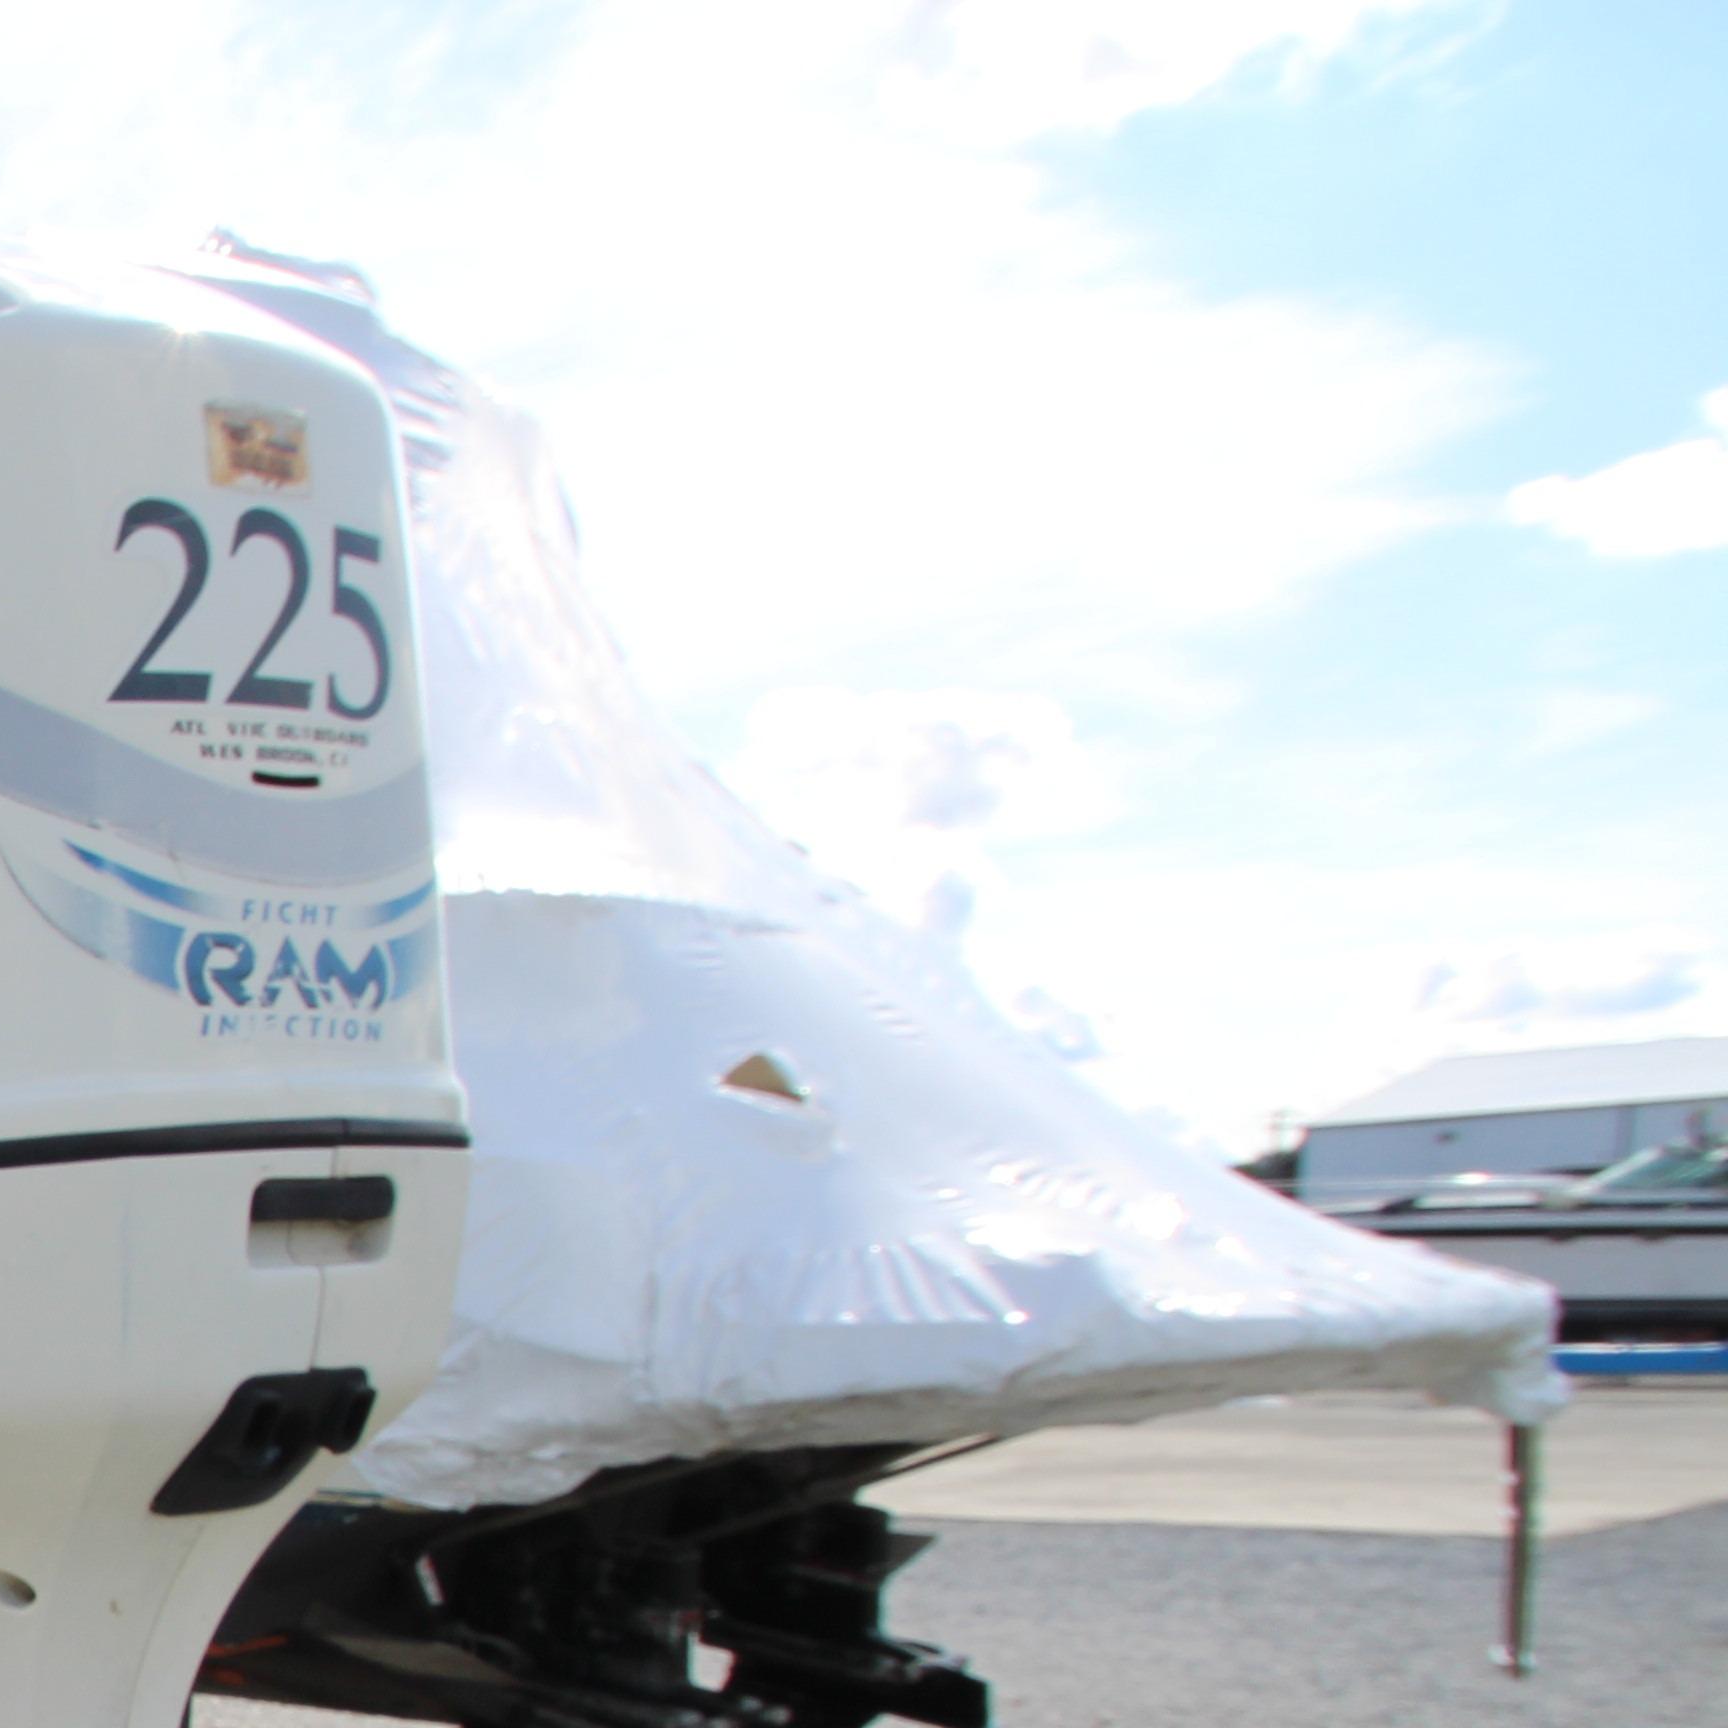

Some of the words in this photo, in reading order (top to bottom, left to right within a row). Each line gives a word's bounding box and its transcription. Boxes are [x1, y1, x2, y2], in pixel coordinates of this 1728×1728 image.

[106, 496, 392, 721] 225
[241, 899, 339, 925] FICHT
[184, 931, 389, 1010] RAM
